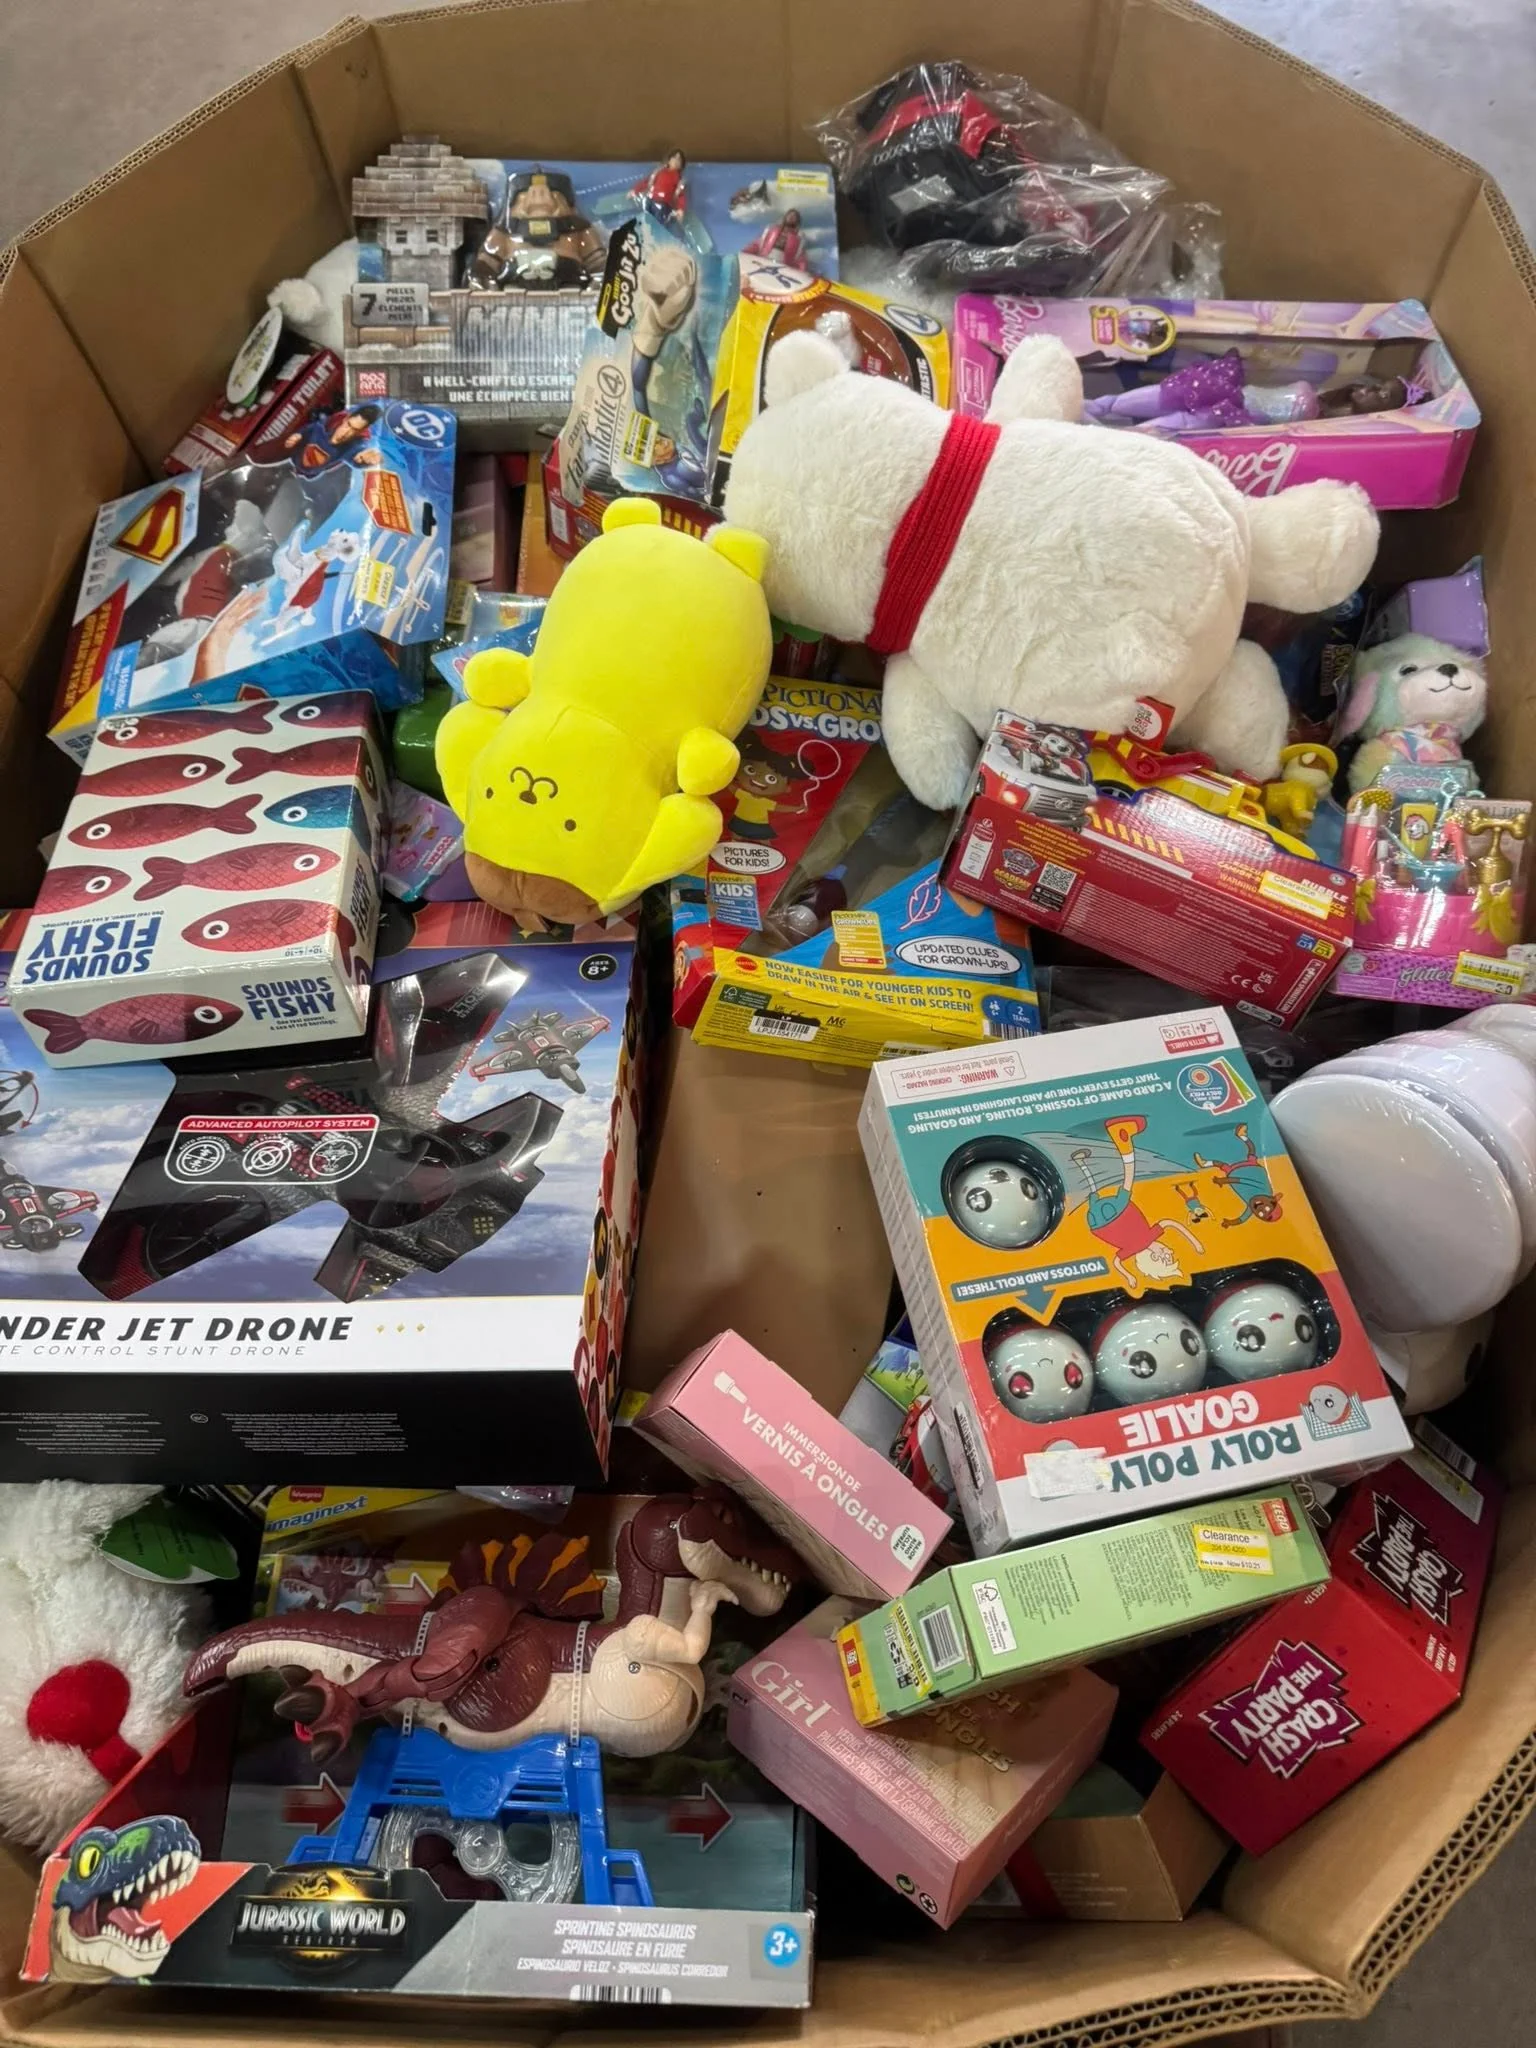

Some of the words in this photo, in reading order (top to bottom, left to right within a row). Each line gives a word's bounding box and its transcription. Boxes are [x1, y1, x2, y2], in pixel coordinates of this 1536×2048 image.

[359, 293, 376, 317] 7
[450, 392, 473, 402] UNE
[541, 391, 569, 401] BIEN
[404, 413, 440, 441] DC
[723, 847, 770, 858] PICTURES
[725, 856, 744, 867] FOR
[745, 857, 770, 867] KIDS!
[715, 885, 754, 897] KIDS
[1273, 875, 1316, 897] Clearance
[27, 916, 162, 961] FISHY
[914, 944, 965, 956] UPDATED
[967, 946, 999, 958] CLUES
[22, 949, 153, 984] SOUNDS
[587, 965, 609, 976] 8+
[918, 955, 939, 964] FOR
[941, 956, 1009, 971] GROWN-UPS!
[241, 976, 331, 1000] SOUNDS
[765, 961, 796, 973] NOW
[798, 969, 837, 984] EASIER
[841, 976, 864, 989] FOR
[867, 981, 924, 995] YOUNGER
[927, 986, 954, 997] KIDS
[956, 988, 972, 999] TO
[767, 970, 801, 986] DRAW
[804, 979, 816, 988] IN
[820, 982, 839, 994] THE
[843, 987, 861, 998] AIR
[864, 990, 872, 1000] &
[875, 992, 895, 1004] SEE
[897, 995, 907, 1004] IT
[910, 997, 926, 1007] ON
[929, 1000, 974, 1012] SCREEN!
[248, 992, 336, 1021] FISHY
[1017, 1006, 1024, 1015] 2
[960, 1068, 999, 1085] WARNING:
[1107, 1077, 1134, 1089] GETS
[1136, 1072, 1160, 1084] THAT
[1164, 1080, 1172, 1090] A
[1022, 1092, 1043, 1103] AND
[1044, 1090, 1058, 1099] UP
[1061, 1082, 1108, 1096] EVERYONE
[1100, 1088, 1133, 1103] GAME
[1133, 1084, 1164, 1096] CARD
[973, 1096, 1021, 1112] LAUGHING
[1031, 1097, 1083, 1114] TOSSING,
[1083, 1094, 1099, 1105] OF
[913, 1107, 963, 1122] MINUTES!
[962, 1105, 972, 1113] IN
[983, 1104, 1032, 1123] ROLLING,
[187, 1120, 253, 1129] ADVANCED
[254, 1120, 321, 1129] AUTOPILOT
[322, 1119, 370, 1128] SYSTEM
[907, 1120, 957, 1134] GOALING
[959, 1114, 983, 1126] AND
[1051, 1266, 1080, 1279] TOSS
[1080, 1261, 1105, 1274] YOU
[996, 1276, 1025, 1289] ROLL
[1025, 1270, 1051, 1284] AND
[957, 1281, 997, 1297] THESE!
[117, 1317, 193, 1342] JET
[203, 1316, 354, 1342] DRONE
[33, 1345, 135, 1356] CONTROL
[147, 1345, 219, 1356] STUNT
[229, 1345, 307, 1356] DRONE
[1118, 1390, 1260, 1448] GOALIE
[782, 1420, 848, 1483] IMMERSION
[1211, 1423, 1302, 1470] ROLY
[741, 1405, 804, 1470] VERNIS
[800, 1456, 816, 1482] À
[816, 1474, 889, 1542] ONGLES
[1109, 1445, 1200, 1492] POLY
[265, 1495, 368, 1532] imaginext
[1271, 1503, 1291, 1532] LEGO
[1396, 1513, 1416, 1540] THE
[1203, 1529, 1250, 1543] Clearance
[904, 1538, 917, 1555] BLING
[908, 1540, 922, 1560] MAJOR
[1377, 1523, 1415, 1592] PARTY
[1407, 1549, 1447, 1608] CRASH
[1289, 1661, 1323, 1690] THE
[750, 1660, 837, 1728] Girl
[1230, 1675, 1304, 1748] PARTY
[1261, 1699, 1338, 1761] CRASH
[854, 1762, 881, 1786] POIDS
[875, 1778, 893, 1796] NET
[899, 1798, 938, 1832] GRAMME
[237, 1902, 325, 1933] JURASSIC
[330, 1906, 406, 1936] WORLD
[554, 1919, 616, 1937] SPRINTING
[616, 1921, 697, 1940] SPINOSAURUS
[283, 1934, 359, 1945] REBIRTH
[768, 1931, 799, 1956] 3+
[561, 1939, 633, 1957] SPINOSAURE
[635, 1943, 651, 1957] EN
[652, 1943, 687, 1959] FURIE
[516, 1957, 581, 1973] ESPINOSAURIO
[583, 1960, 611, 1973] VELOZ
[616, 1961, 680, 1976] SPINOSAURUS
